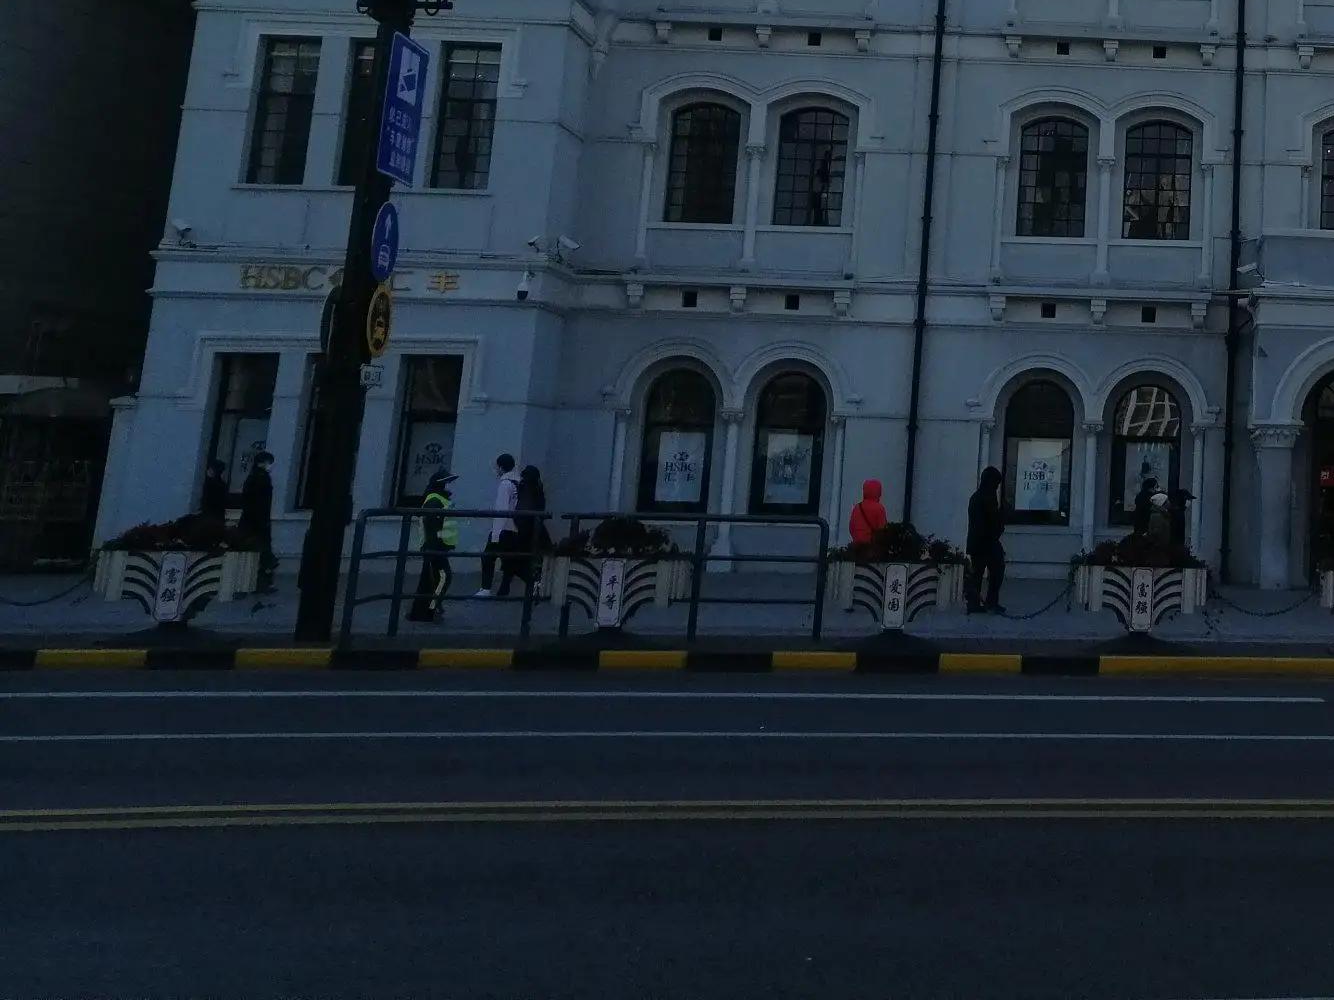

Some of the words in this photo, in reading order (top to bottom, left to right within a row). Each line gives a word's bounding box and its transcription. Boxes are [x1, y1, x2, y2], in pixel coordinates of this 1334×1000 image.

[240, 264, 326, 291] HSBC
[665, 461, 697, 472] HSBC
[1024, 471, 1055, 481] HSBC
[606, 575, 619, 610] 平等
[888, 579, 902, 612] 爱国
[1135, 582, 1150, 615] 富强
